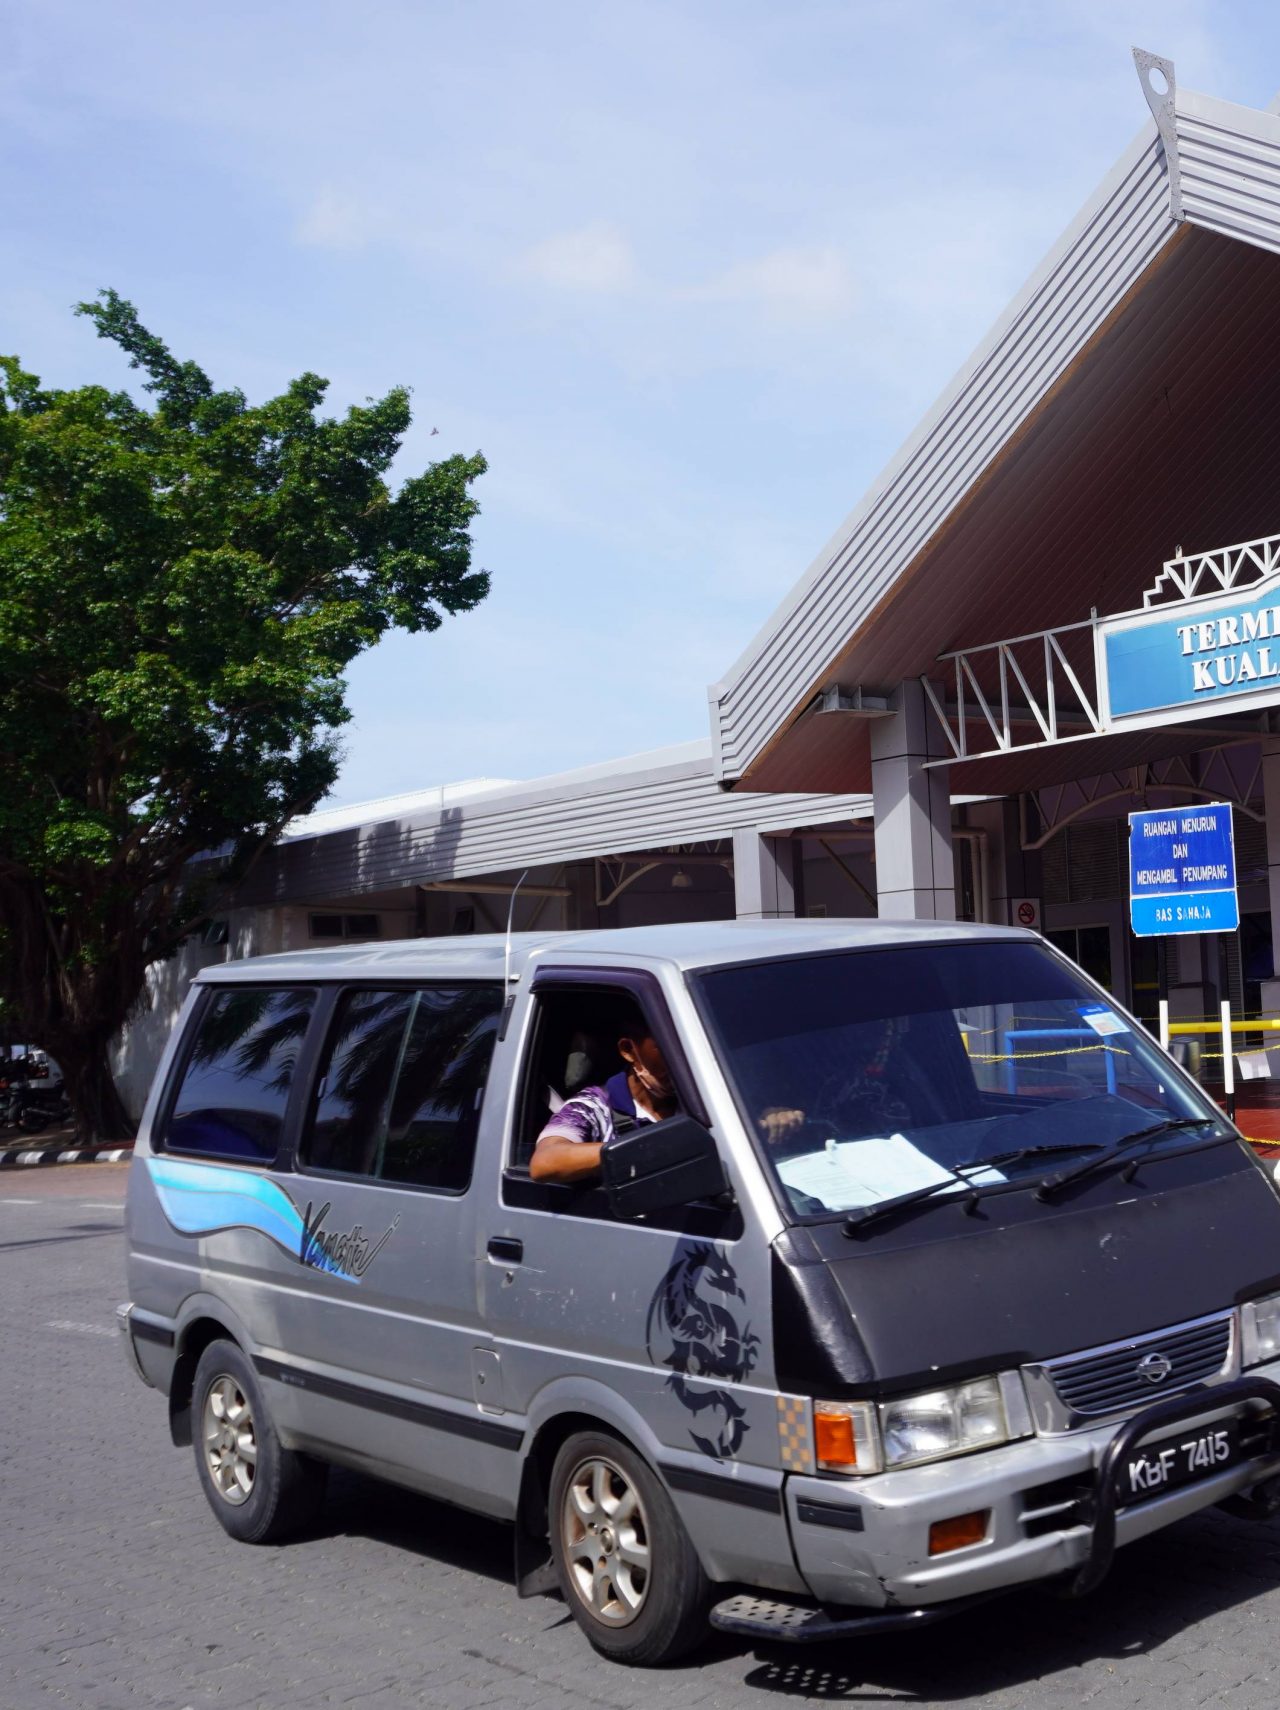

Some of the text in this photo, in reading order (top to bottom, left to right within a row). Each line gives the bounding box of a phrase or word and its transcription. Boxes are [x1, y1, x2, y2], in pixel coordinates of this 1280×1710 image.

[1143, 815, 1217, 838] RUANGAN MENURUN
[1172, 843, 1188, 859] DAN
[1136, 864, 1228, 885] MENGAMBIL PENUMPANG
[1155, 905, 1212, 922] BAS SAHAJA
[1128, 1430, 1230, 1493] KBF 7415
